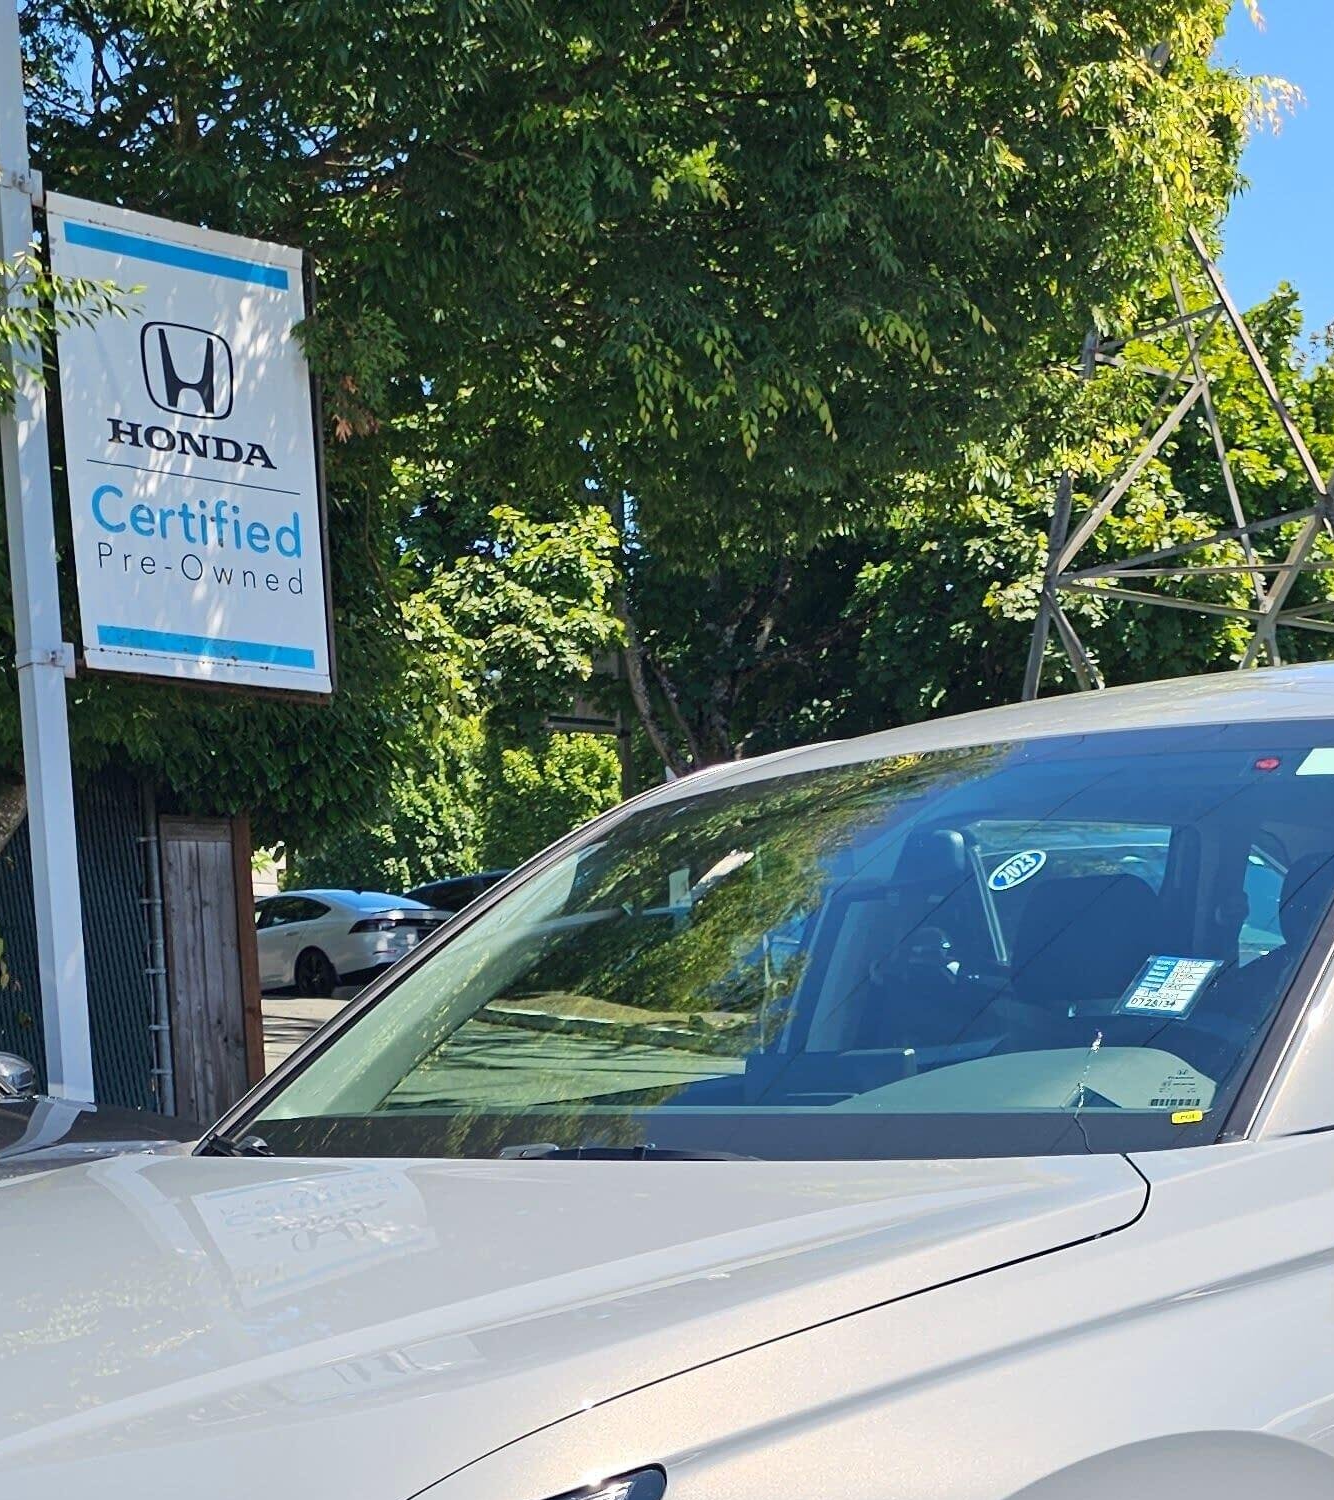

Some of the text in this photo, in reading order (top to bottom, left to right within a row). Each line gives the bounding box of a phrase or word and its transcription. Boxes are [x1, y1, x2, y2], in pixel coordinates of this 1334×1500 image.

[107, 418, 278, 470] HONDA
[92, 484, 302, 559] Certified
[98, 541, 304, 595] Pre-Owned
[998, 854, 1037, 885] 2023
